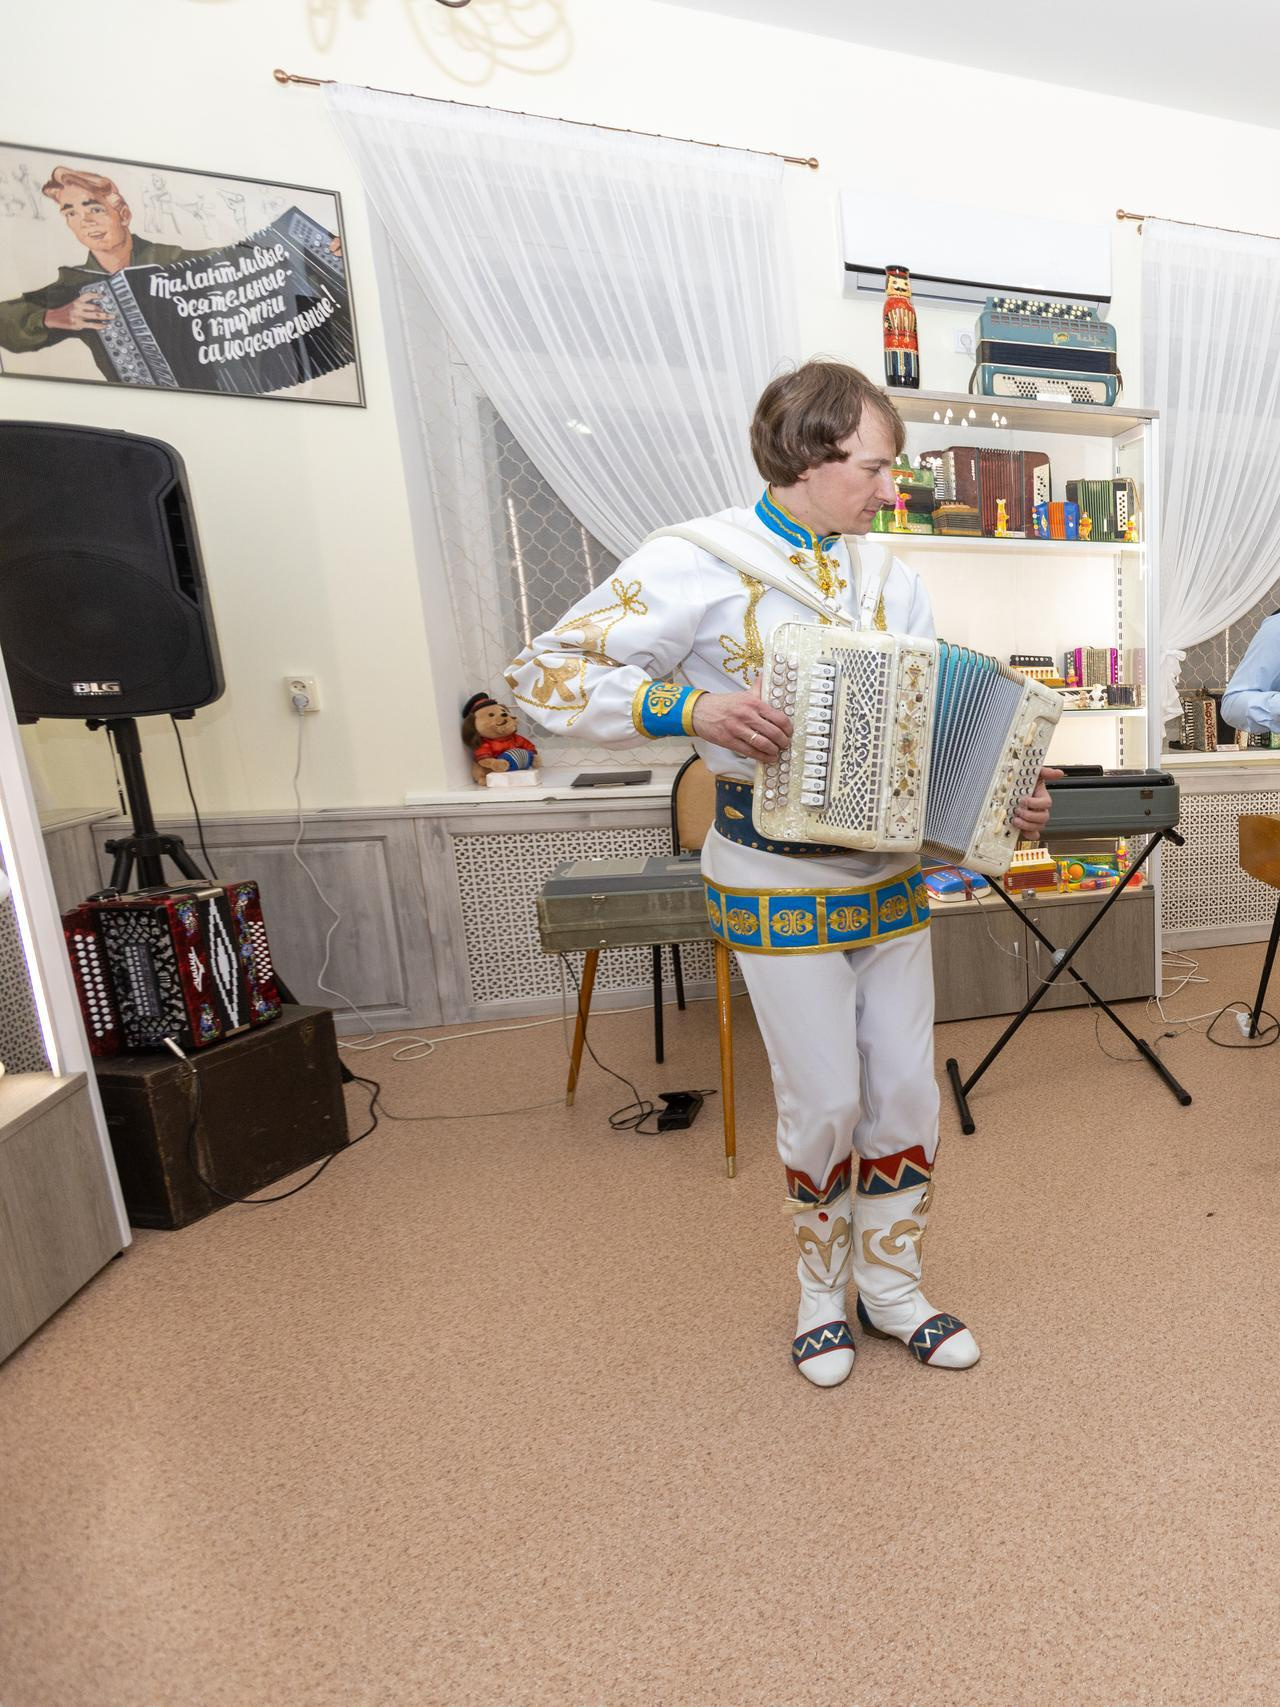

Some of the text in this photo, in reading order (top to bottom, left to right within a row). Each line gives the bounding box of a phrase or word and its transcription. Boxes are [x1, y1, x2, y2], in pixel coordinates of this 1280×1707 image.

[191, 295, 287, 342] в кружки
[198, 284, 342, 365] самодеятельные!
[72, 682, 120, 693] BLG
